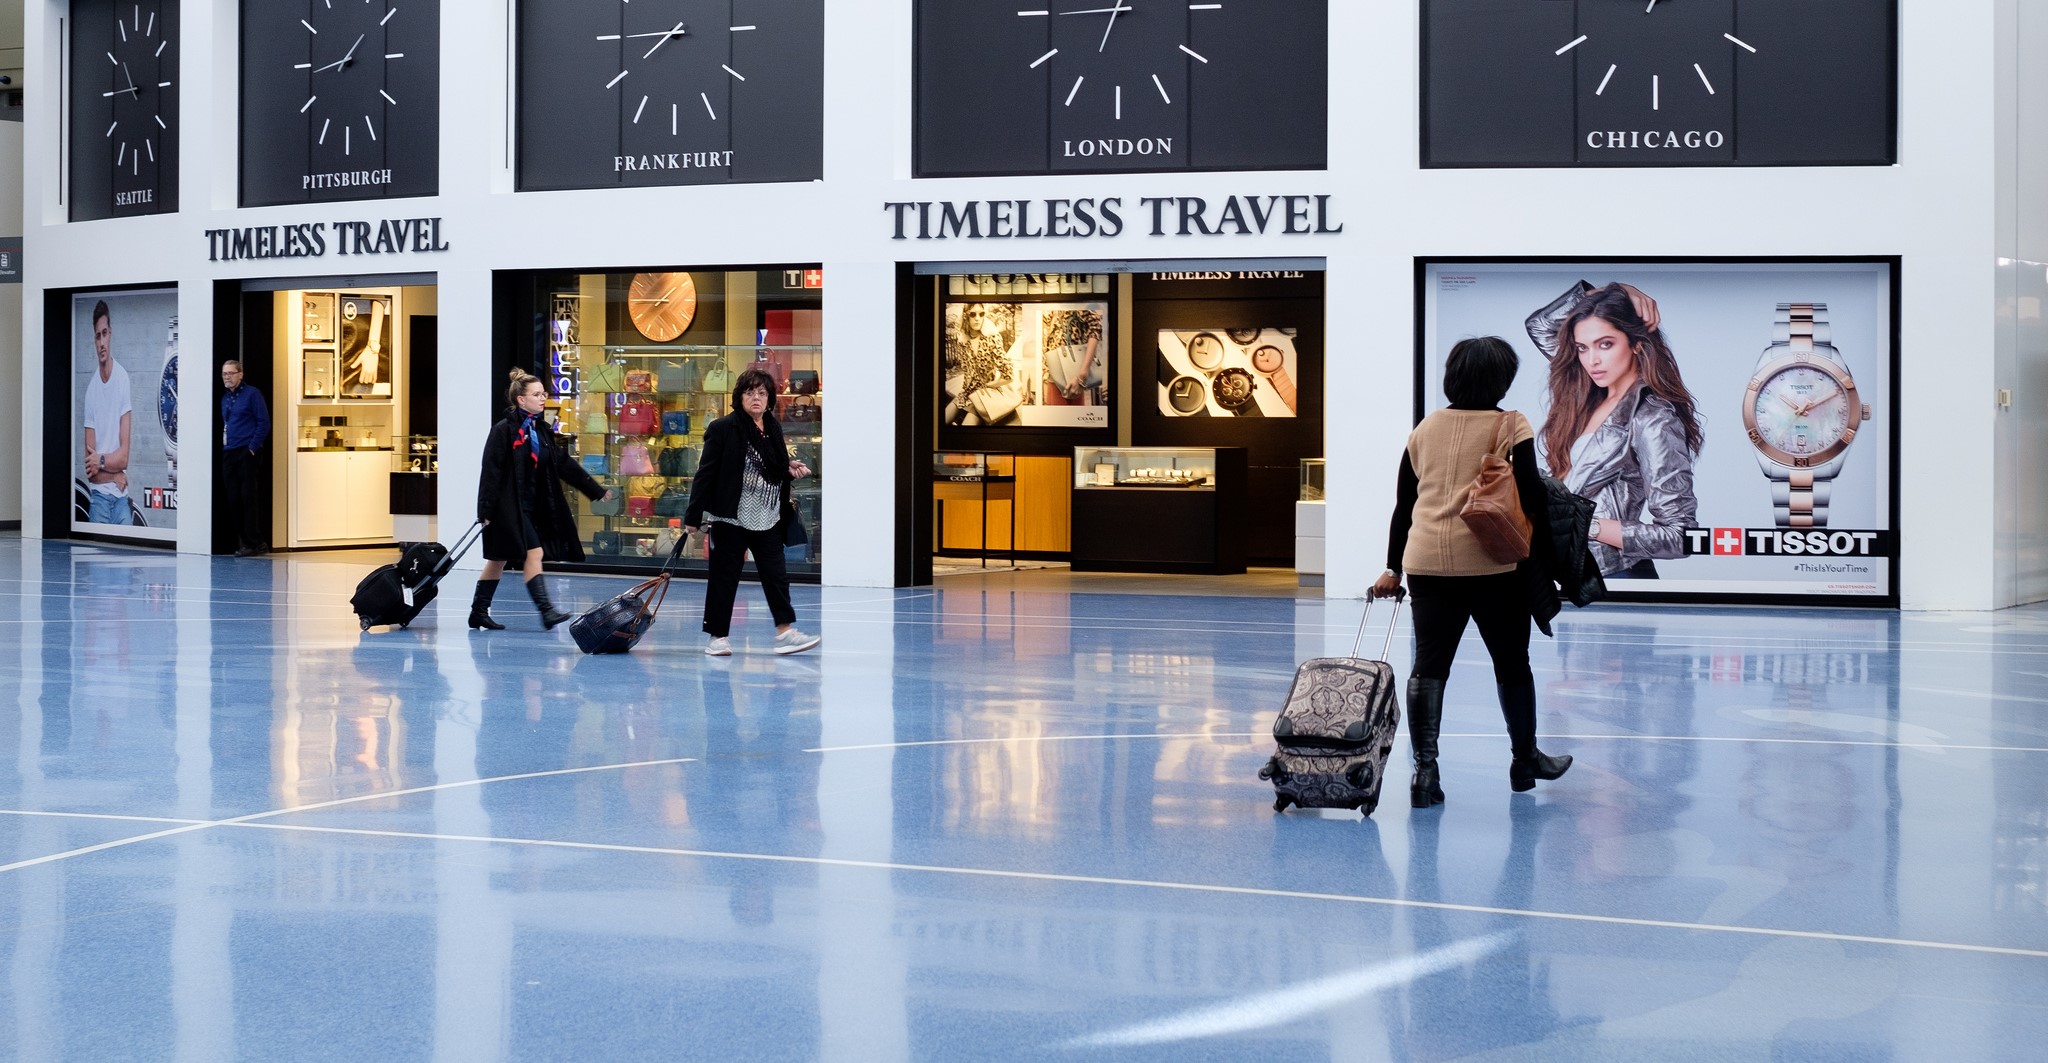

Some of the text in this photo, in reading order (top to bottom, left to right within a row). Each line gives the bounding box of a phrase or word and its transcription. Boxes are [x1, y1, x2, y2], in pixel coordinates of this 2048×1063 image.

[1063, 138, 1173, 156] LONDON
[1586, 130, 1724, 148] CHICAGO
[614, 150, 734, 171] FRANKFURT
[302, 169, 392, 189] PITTSBURGH
[116, 189, 153, 206] SEATTLE
[884, 194, 1344, 239] TIMELESS TRAVEL
[204, 217, 450, 262] TIMELESS TRAVEL
[1748, 531, 1877, 555] TISSOT
[1793, 563, 1869, 573] #ThisIsYourTime
